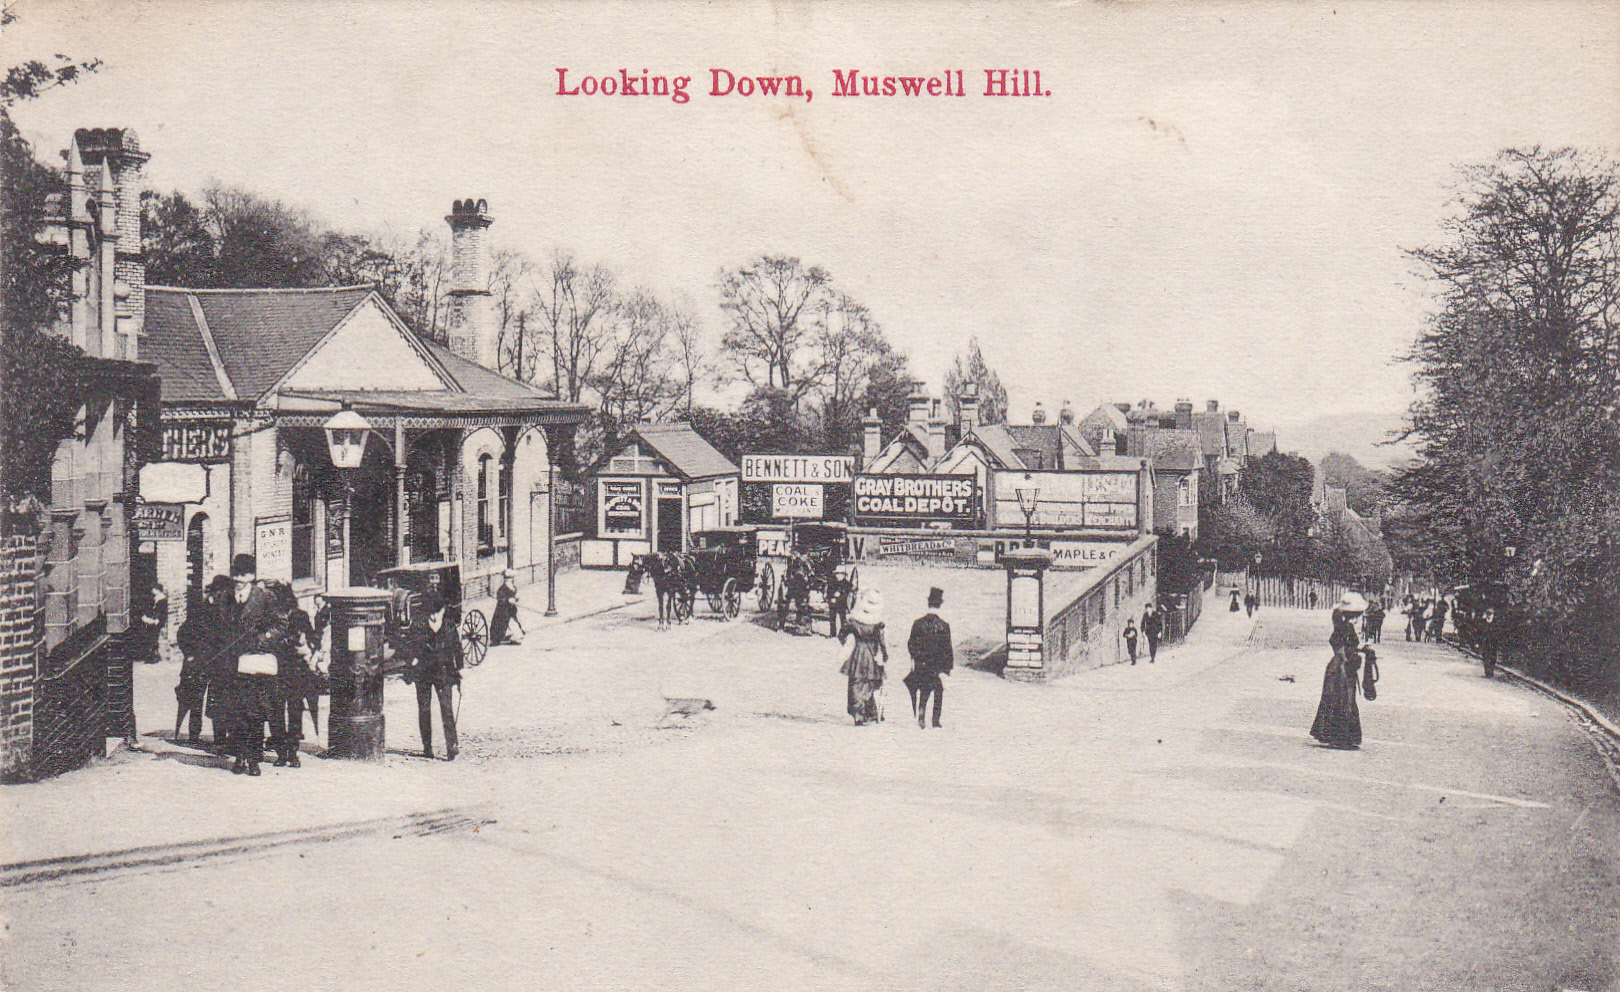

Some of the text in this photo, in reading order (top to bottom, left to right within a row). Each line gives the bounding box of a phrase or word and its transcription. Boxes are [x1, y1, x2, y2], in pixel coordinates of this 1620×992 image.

[745, 458, 853, 478] BENNETT & SON
[776, 486, 808, 496] COAL
[855, 477, 972, 497] GRAY BROTHERS
[778, 497, 818, 507] COKE
[857, 496, 904, 512] COAL
[882, 541, 936, 553] WHITBREAD
[1053, 549, 1097, 560] MAPLE
[1099, 551, 1106, 560] &
